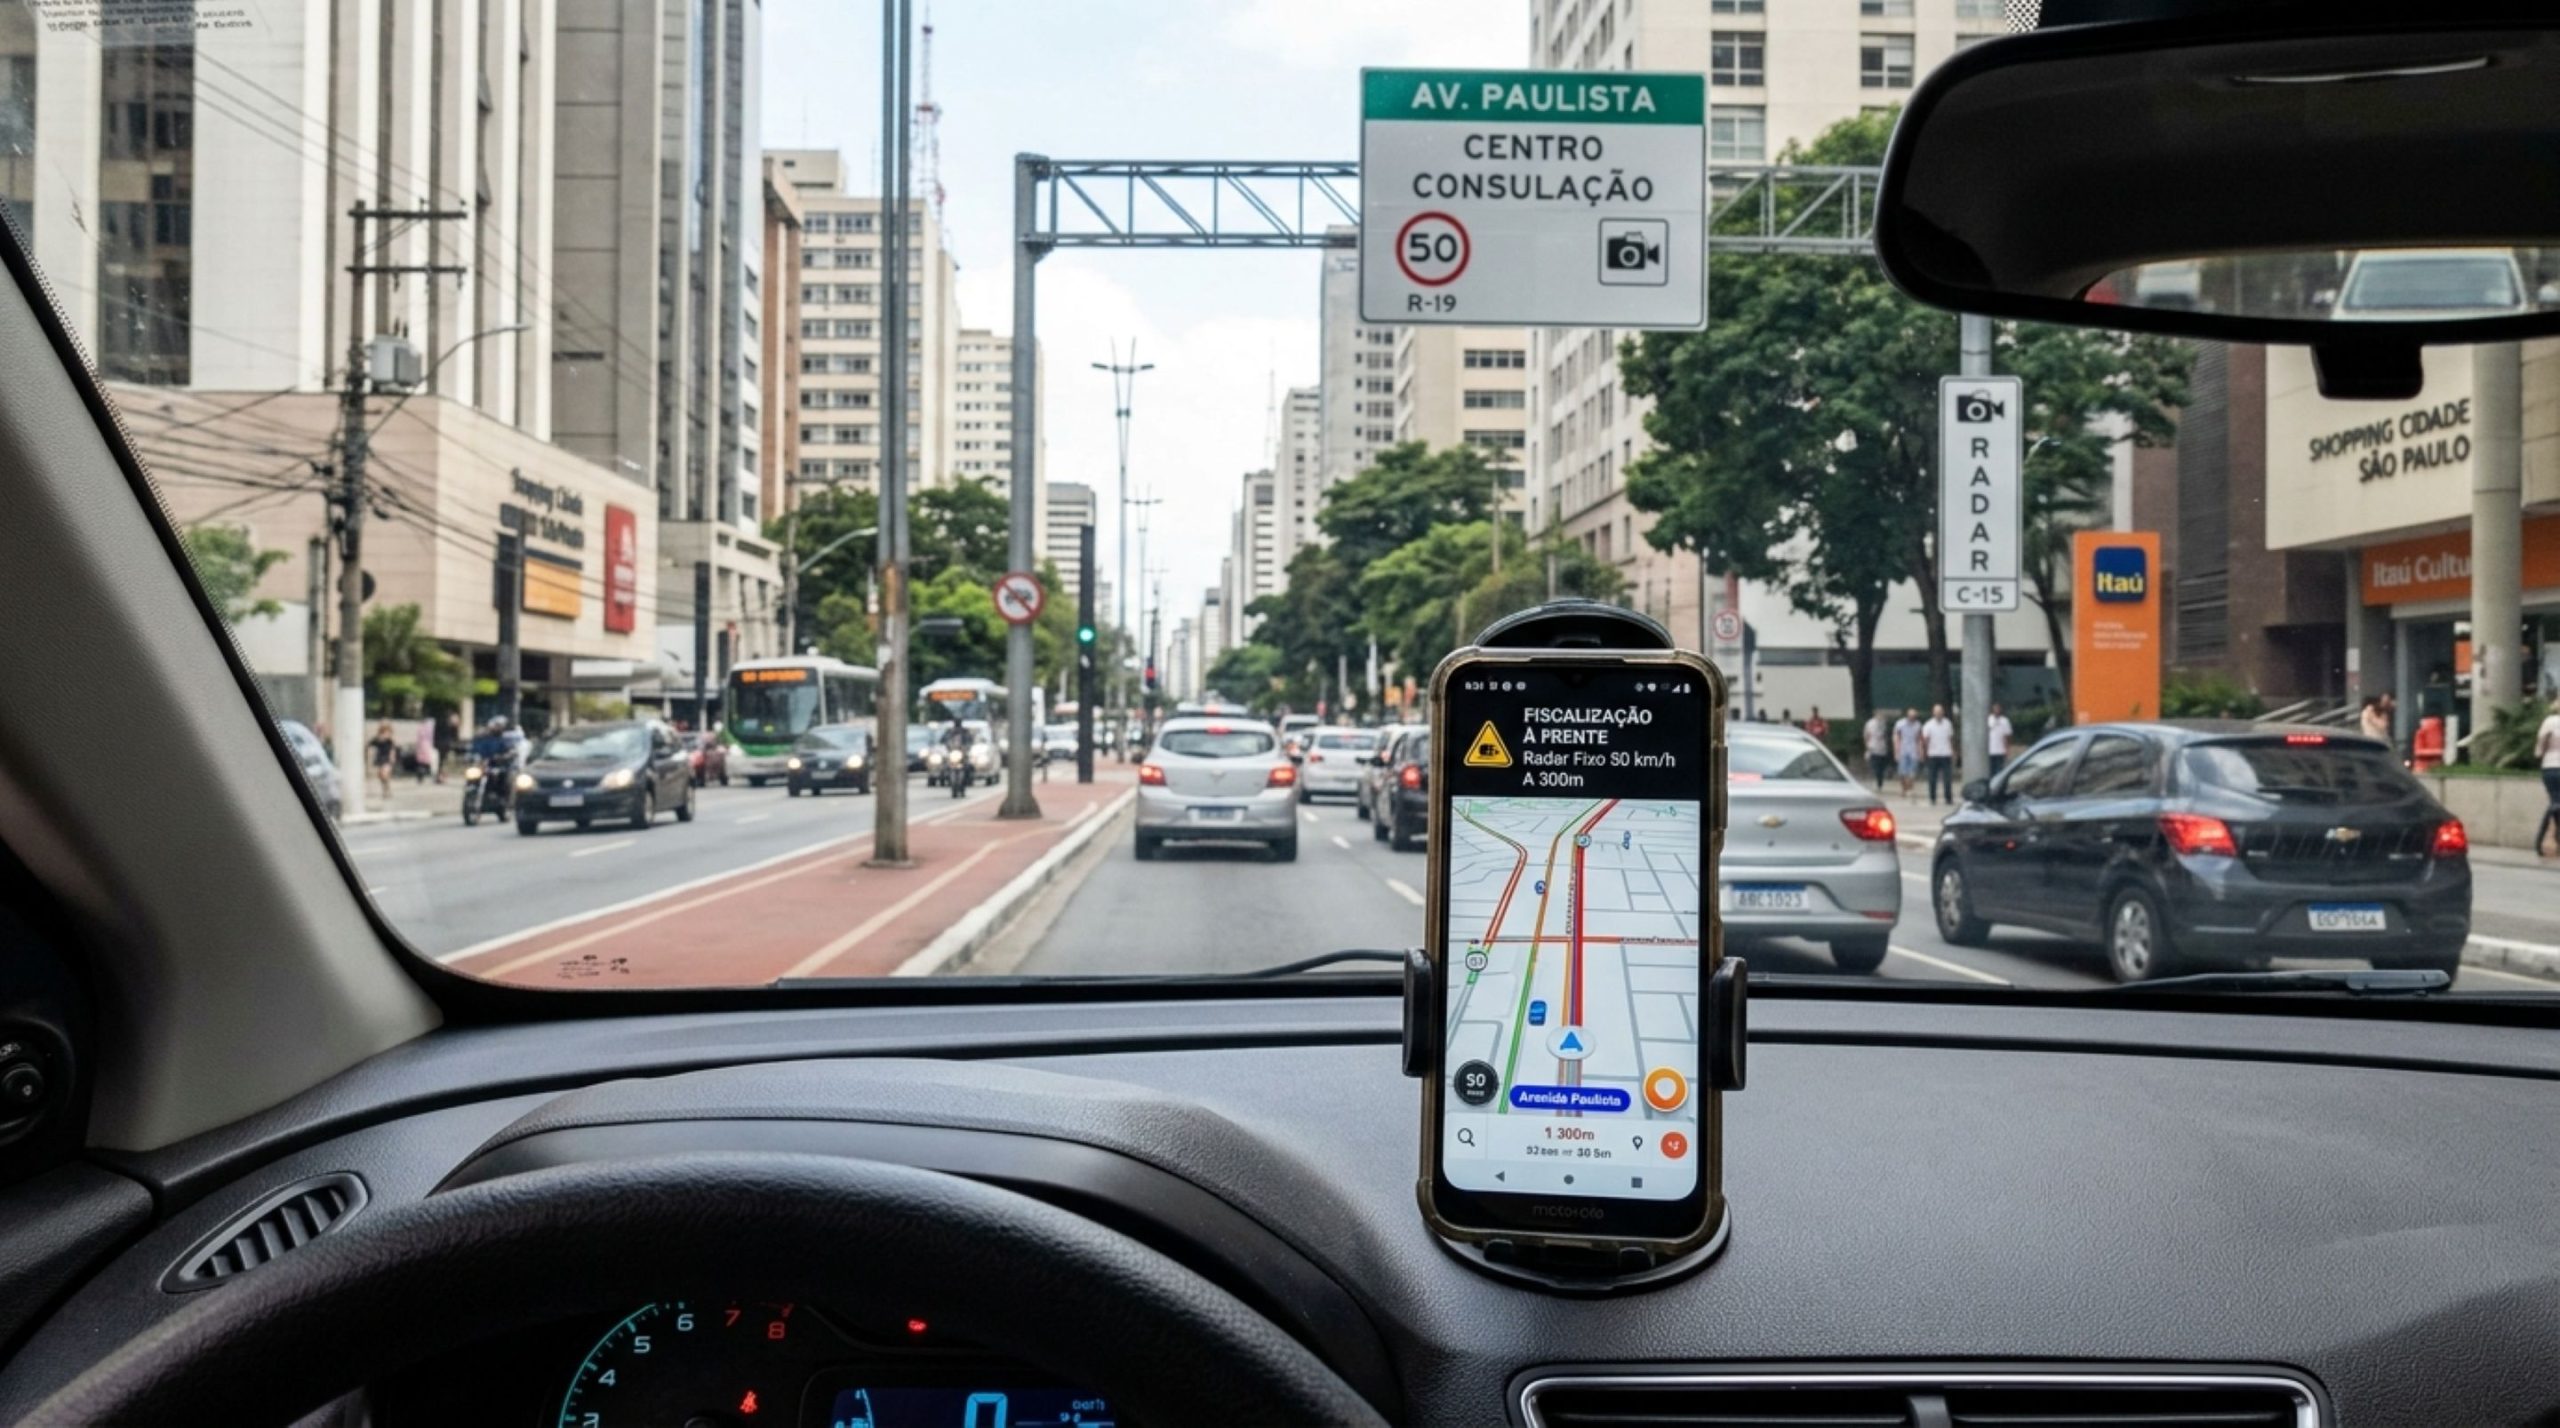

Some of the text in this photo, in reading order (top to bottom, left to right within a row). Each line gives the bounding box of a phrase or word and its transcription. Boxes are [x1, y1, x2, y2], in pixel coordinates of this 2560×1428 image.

[1411, 83, 1657, 113] AV. PAULISTA
[1464, 134, 1604, 162] CENTRO
[1412, 169, 1655, 207] CONSULAÇÃO
[1408, 233, 1459, 263] 50
[1407, 294, 1458, 313] R-19
[2309, 398, 2471, 463] SHOPPING CIDADE
[2358, 434, 2471, 484] SÃO PAULO
[1970, 437, 1991, 572] RADAR
[2097, 571, 2144, 594] Itaú
[2373, 556, 2412, 588] Itaú
[1956, 586, 2004, 604] C-15
[1523, 705, 1653, 728] FISCALIZAÇÃO
[1573, 752, 1606, 767] Fixo
[1634, 751, 1676, 768] km/h
[1523, 773, 1584, 788] A 300m
[1557, 1128, 1595, 1141] 300m
[677, 1313, 693, 1331] 6
[725, 1310, 740, 1327] 7
[768, 1322, 785, 1340] 8
[633, 1336, 651, 1354] 5
[598, 1369, 616, 1387] 4
